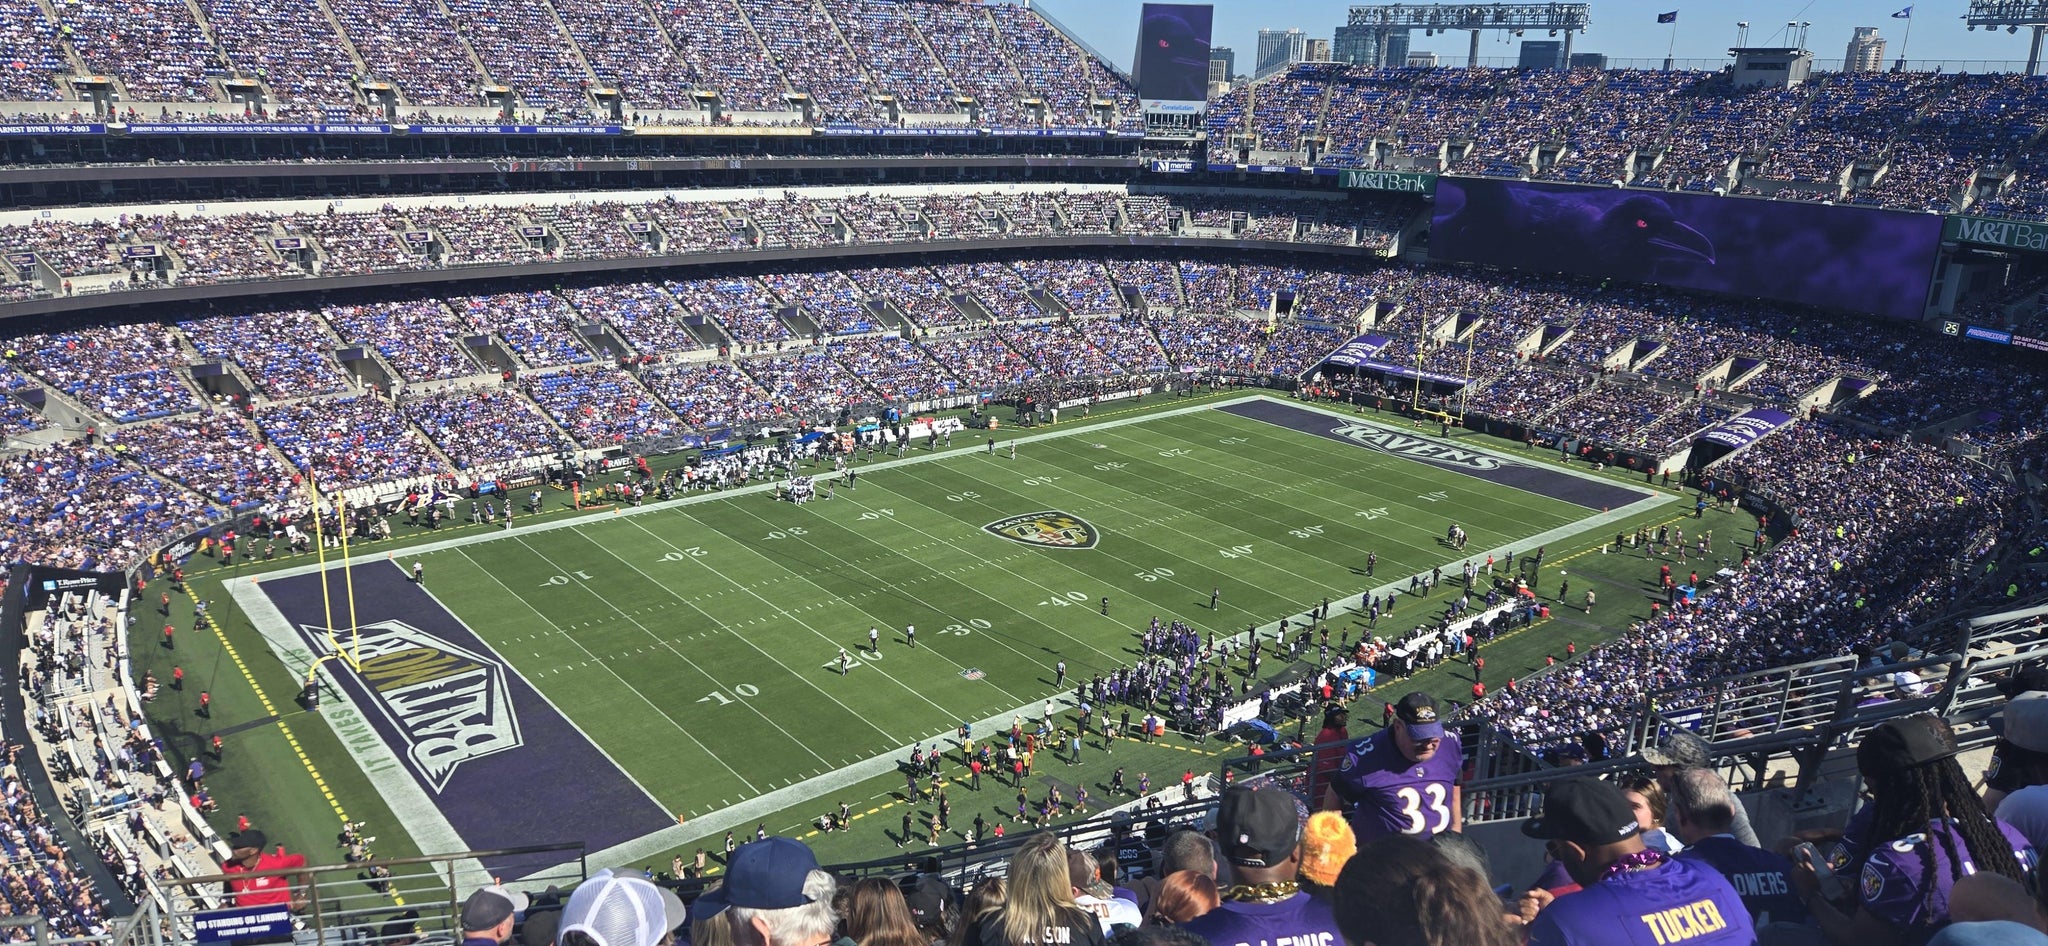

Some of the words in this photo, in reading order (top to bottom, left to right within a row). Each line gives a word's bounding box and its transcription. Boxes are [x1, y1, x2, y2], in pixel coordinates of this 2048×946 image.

[1347, 171, 1388, 189] M&T
[1388, 173, 1425, 191] Bank
[1956, 217, 2015, 245] M&T
[1945, 323, 1957, 334] 25
[1967, 328, 2011, 342] PROGRESSIVE
[933, 400, 940, 409] OF
[943, 398, 956, 408] THE
[1059, 397, 1090, 408] BALTIMOR
[1098, 391, 1130, 402] MARCHING
[1331, 420, 1502, 471] RAVENS
[947, 491, 981, 502] 50
[1417, 491, 1447, 502] 10
[862, 508, 894, 520] 40
[1355, 508, 1387, 521] 20
[769, 527, 808, 540] 30
[1288, 526, 1322, 539] 30
[665, 547, 708, 561] 20
[1219, 546, 1252, 560] 40
[550, 570, 593, 585] 10
[1134, 567, 1175, 583] 50
[1049, 591, 1088, 607] 40
[947, 618, 992, 636] 30
[311, 621, 519, 780] BALTIMORE
[710, 683, 760, 706] 10
[330, 709, 380, 755] TAKES
[364, 756, 396, 773] IT
[1397, 783, 1450, 835] 33
[1733, 872, 1788, 896] OWERS
[207, 916, 244, 929] STANDING
[256, 912, 289, 923] LANDING
[1641, 899, 1727, 946] TUCKER
